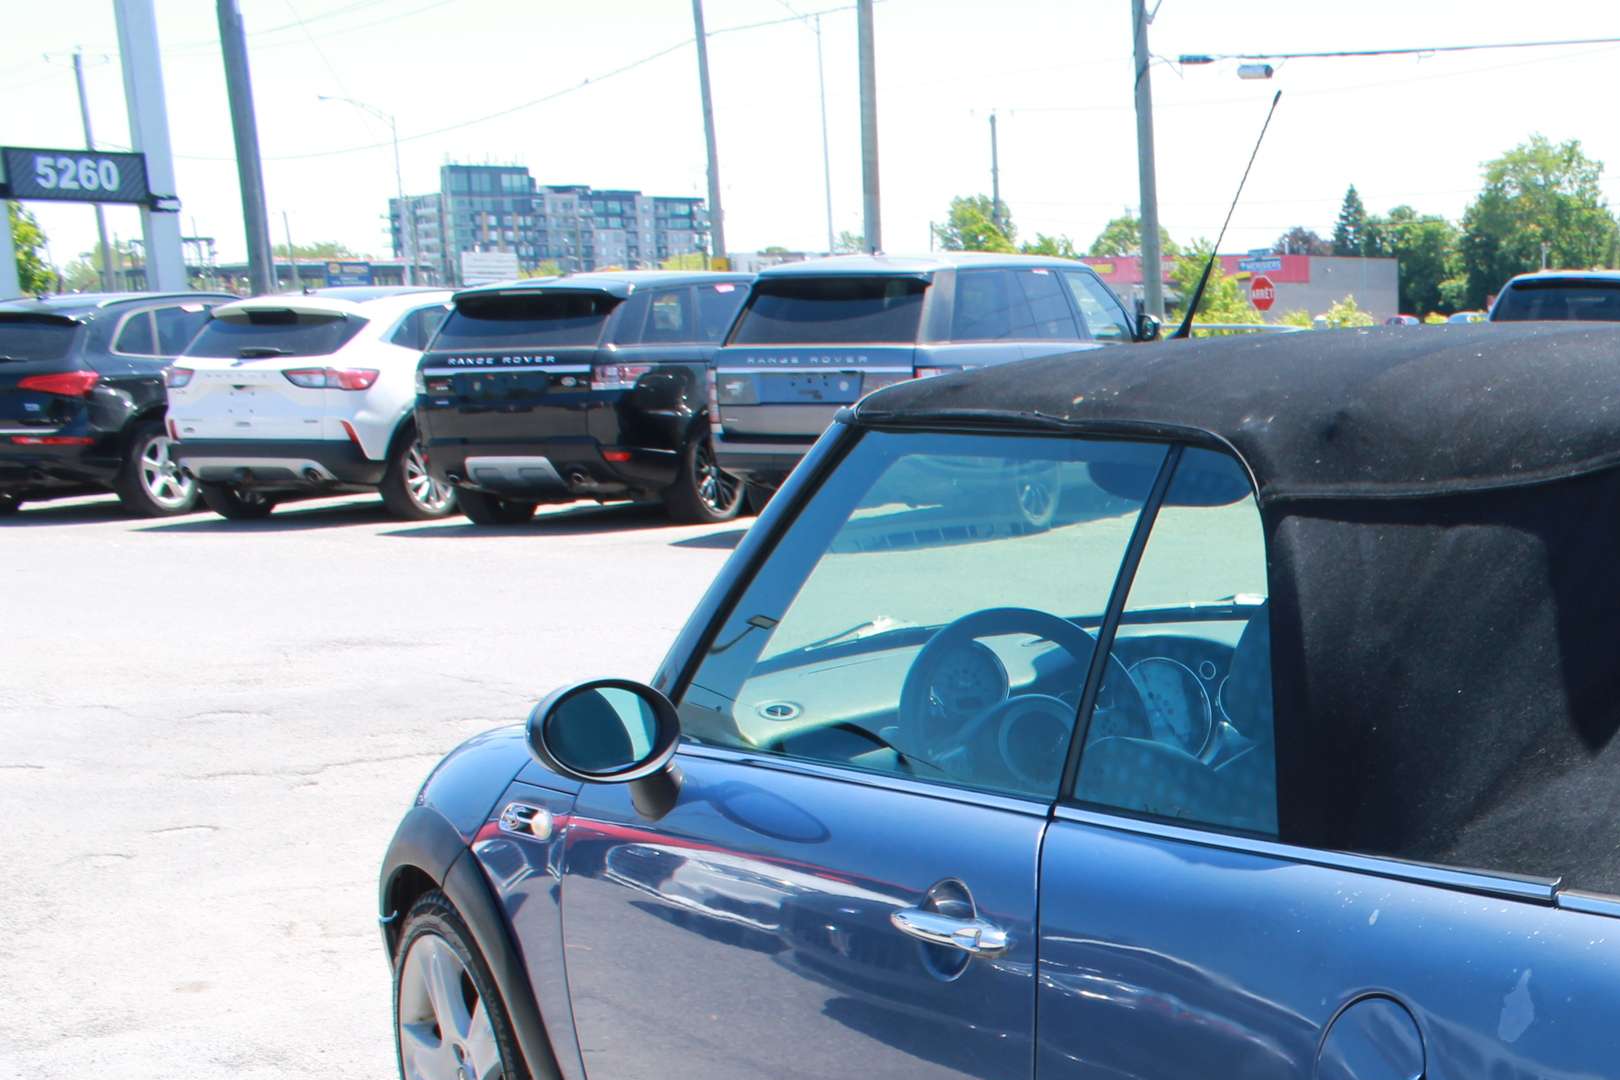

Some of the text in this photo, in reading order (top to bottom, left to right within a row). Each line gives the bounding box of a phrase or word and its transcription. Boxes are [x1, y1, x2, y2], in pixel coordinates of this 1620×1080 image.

[35, 156, 120, 192] 5260
[448, 355, 557, 366] RANGE ROVER
[747, 355, 868, 364] RANGE ROVER
